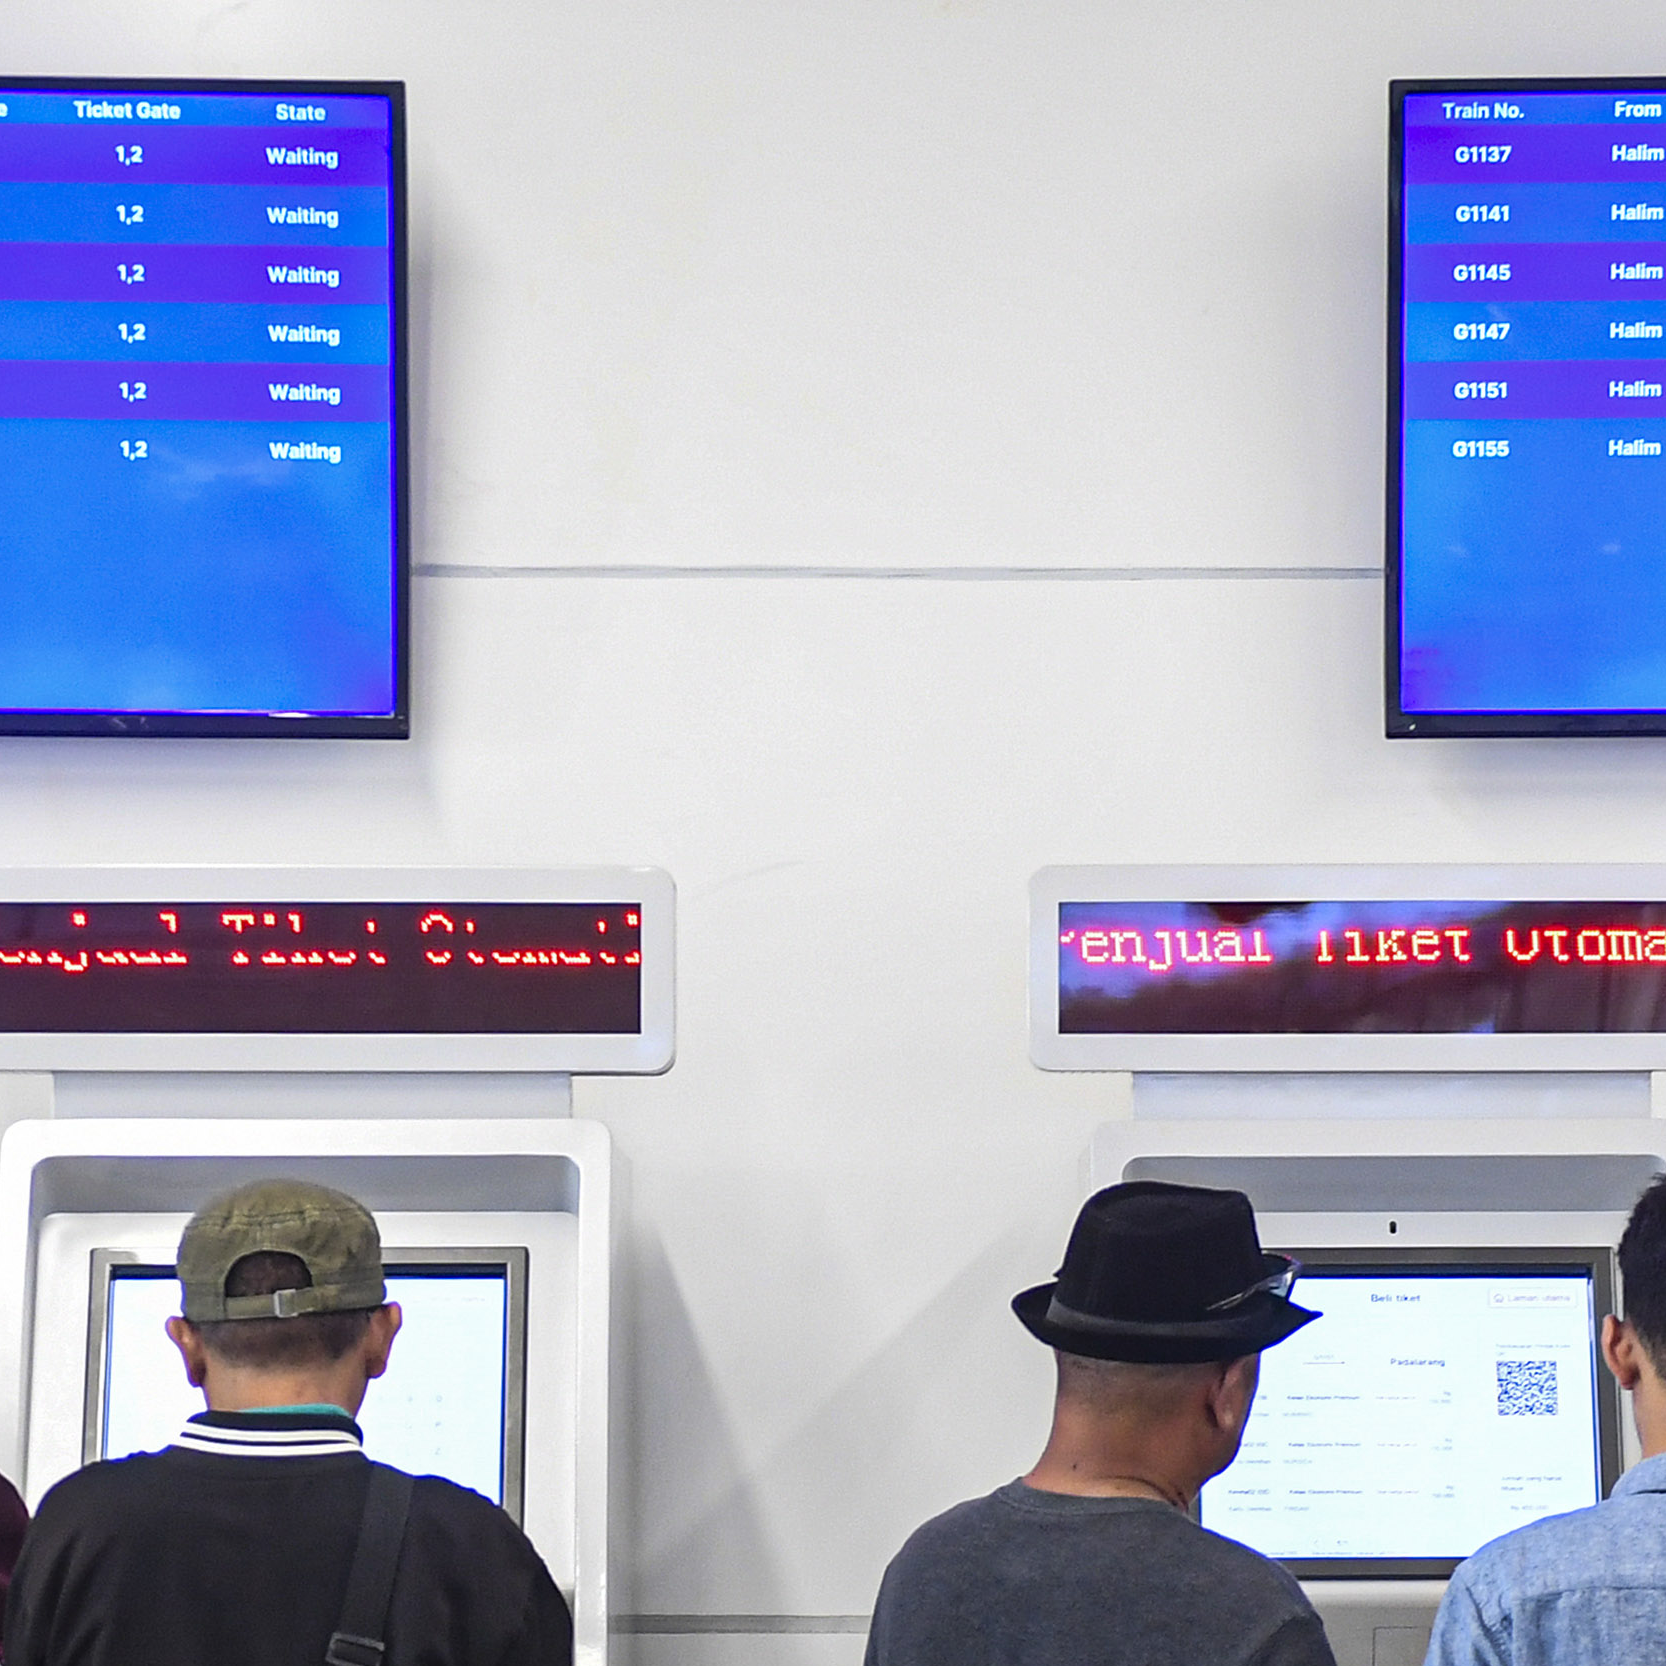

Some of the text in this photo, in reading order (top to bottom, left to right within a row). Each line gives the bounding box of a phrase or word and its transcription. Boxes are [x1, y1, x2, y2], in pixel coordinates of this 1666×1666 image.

[72, 99, 134, 120] Ticket
[135, 101, 182, 120] Gate
[275, 102, 327, 122] State
[1441, 101, 1491, 120] Train
[1493, 101, 1525, 120] No.
[1613, 99, 1663, 118] From
[113, 143, 145, 168] 1,2
[264, 145, 340, 171] Waiting
[1453, 143, 1514, 165] G1137
[1610, 142, 1666, 163] Halim
[114, 203, 145, 227] 1,2
[265, 205, 340, 230] Waiting
[1454, 203, 1511, 224] G1141
[1609, 201, 1666, 222] Halim
[115, 262, 146, 287] 1,2
[265, 264, 341, 289] Waiting
[1452, 262, 1513, 283] G1145
[1609, 260, 1665, 282] Halim
[116, 321, 148, 346] 1,2
[266, 323, 342, 348] Waiting
[1452, 321, 1512, 342] G1147
[1608, 319, 1665, 340] Halim
[117, 380, 148, 404] 1,2
[267, 381, 342, 407] Waiting
[1453, 380, 1509, 400] G1151
[1607, 378, 1664, 399] Halim
[118, 439, 149, 463] 1,2
[267, 440, 343, 465] Waiting
[1451, 438, 1511, 459] G1155
[1607, 437, 1663, 458] Halim
[1059, 929, 1272, 971] enjual
